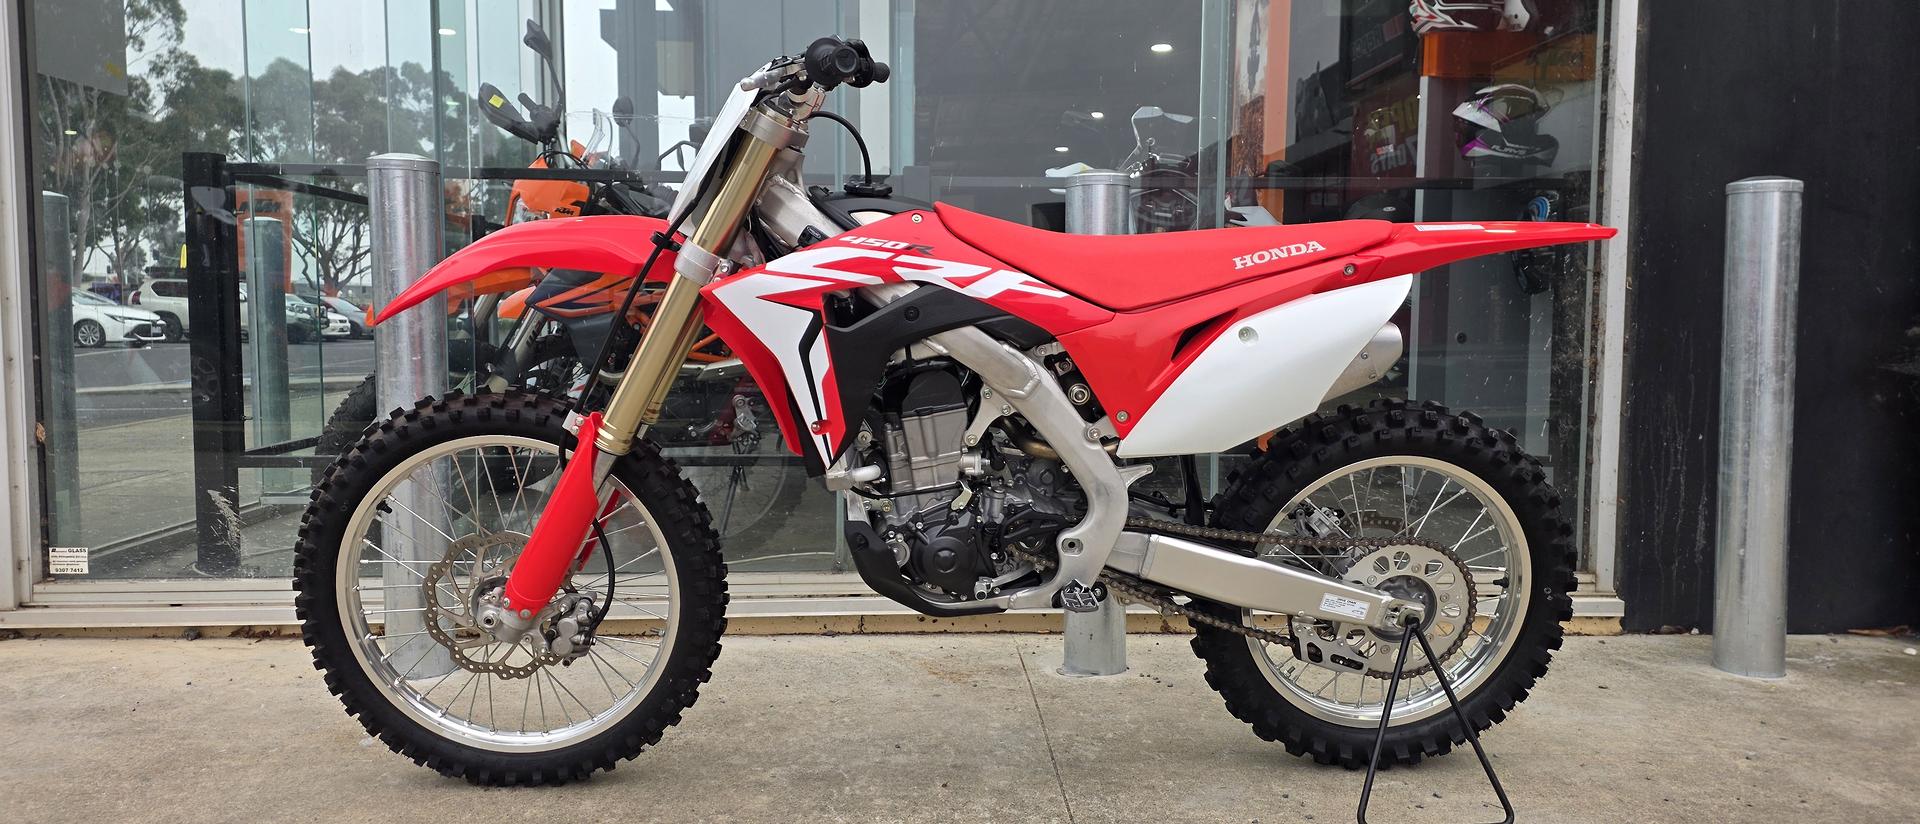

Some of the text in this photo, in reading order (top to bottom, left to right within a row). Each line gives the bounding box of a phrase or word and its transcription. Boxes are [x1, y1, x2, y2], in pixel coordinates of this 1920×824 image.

[554, 206, 576, 216] KTM
[838, 236, 935, 255] 450R
[1232, 240, 1326, 270] HONDA
[765, 246, 1070, 299] CRF
